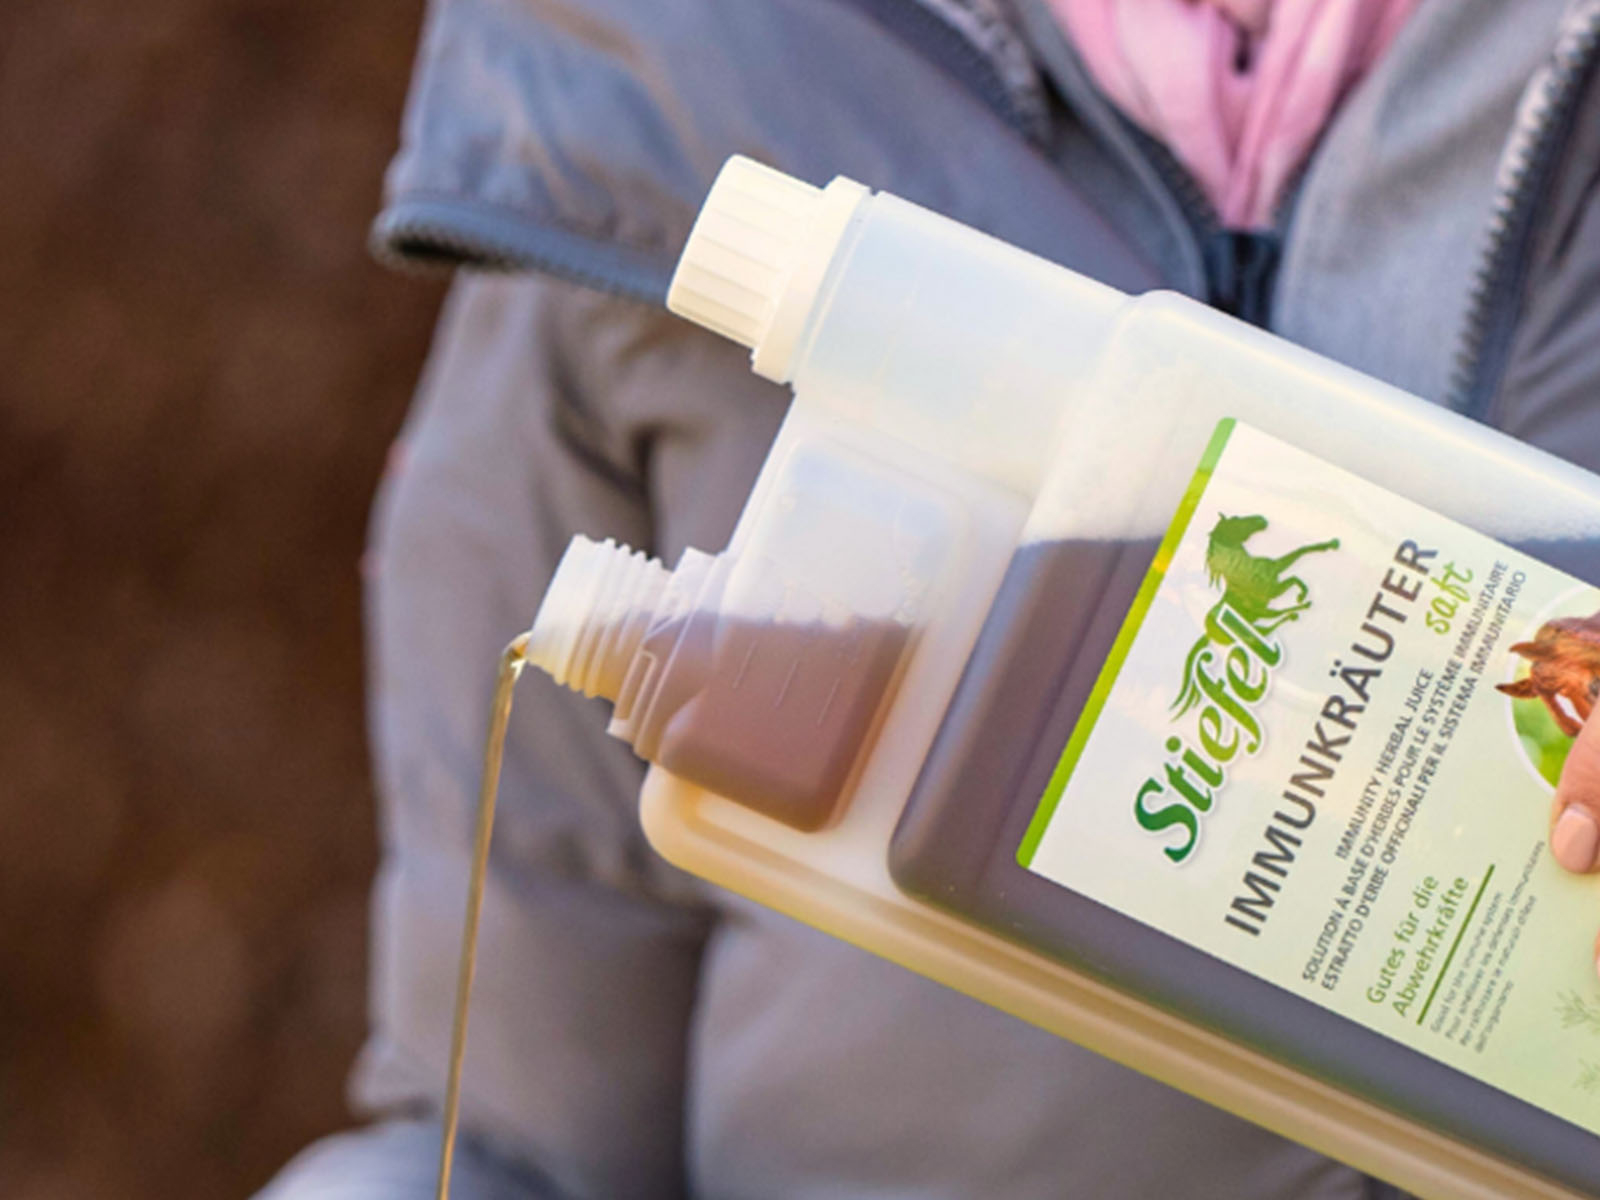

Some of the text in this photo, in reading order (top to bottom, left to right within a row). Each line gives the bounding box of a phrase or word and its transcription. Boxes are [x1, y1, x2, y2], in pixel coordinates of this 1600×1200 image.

[1427, 564, 1472, 632] saft
[1133, 607, 1280, 862] Stiefel
[1224, 540, 1437, 936] IMMUNKRÄUTER
[1301, 910, 1344, 982] SOLUTION
[1341, 857, 1368, 896] BASE
[1359, 788, 1401, 858] D'HERBES
[1392, 744, 1421, 787] POUR
[1413, 726, 1430, 745] LE
[1453, 560, 1508, 658] IMMUNITAIRE
[1320, 570, 1525, 990] ESTRATTO D'ERBE OFFICINALI PER IL SISTEMA IMMUNITARIO
[1334, 668, 1433, 859] IMMUNITY HERBAL JUICE
[1366, 876, 1438, 1003] Gutes für die
[1391, 877, 1468, 1018] Abwehrkräfte
